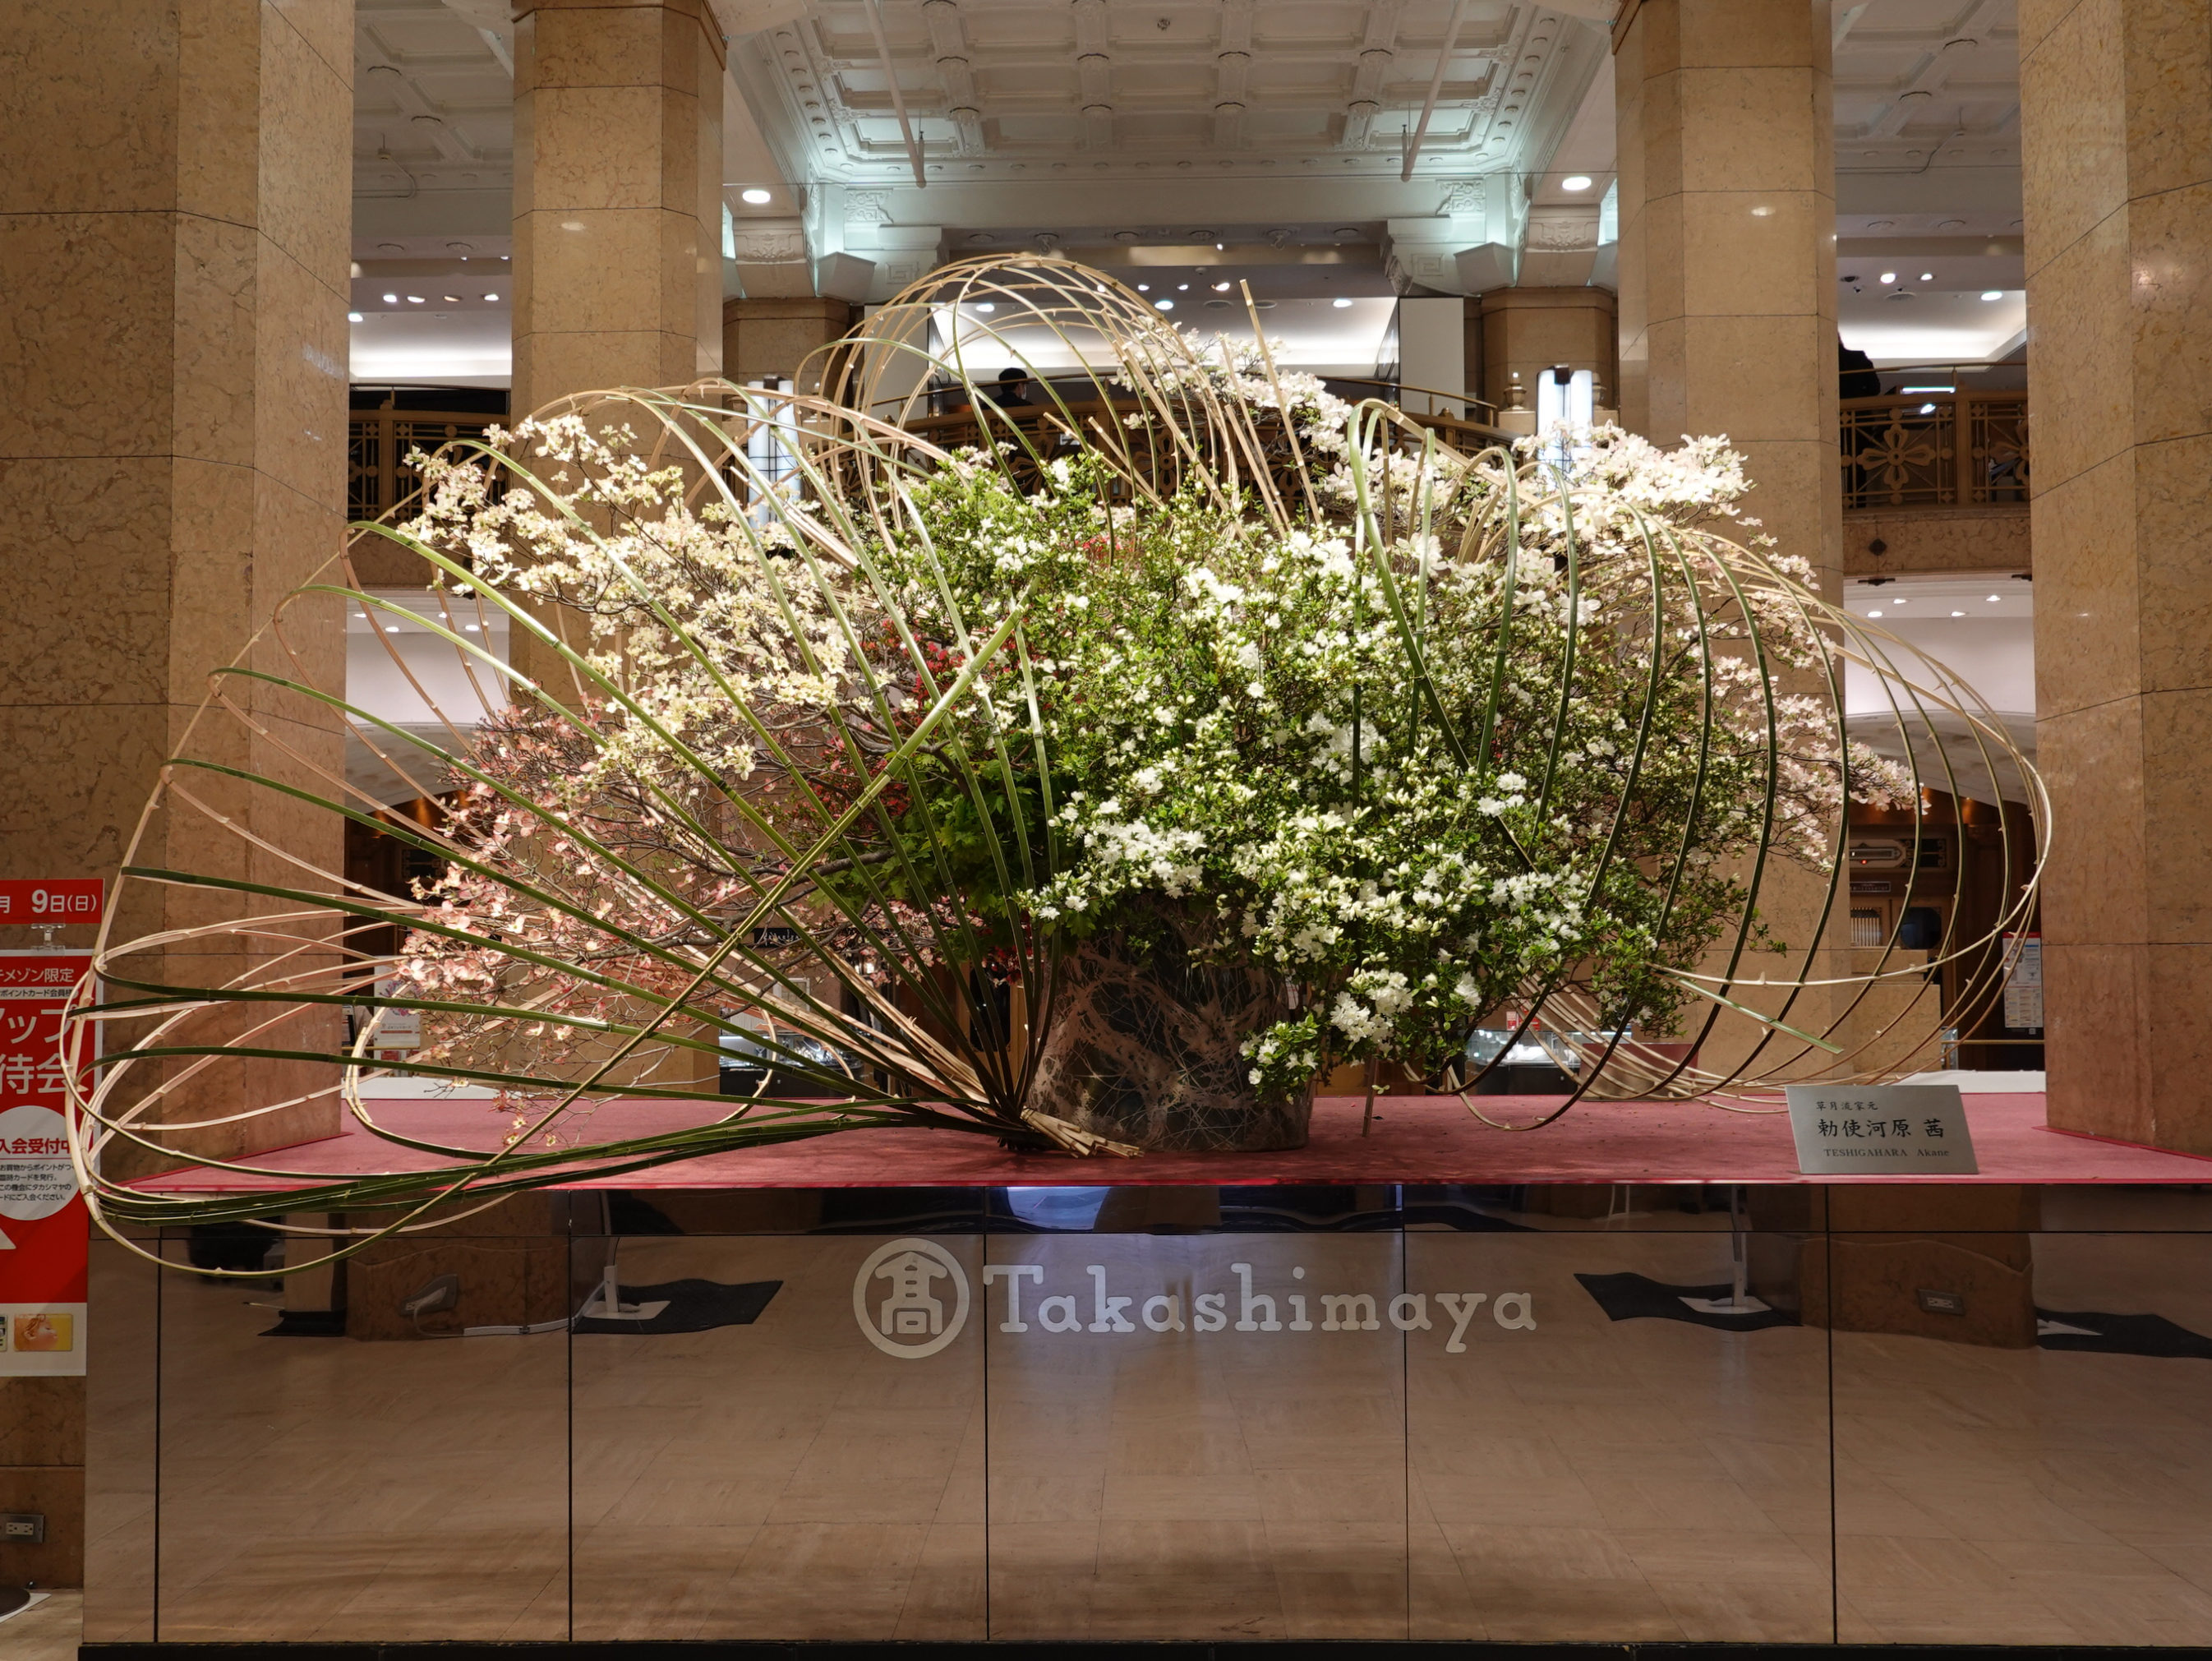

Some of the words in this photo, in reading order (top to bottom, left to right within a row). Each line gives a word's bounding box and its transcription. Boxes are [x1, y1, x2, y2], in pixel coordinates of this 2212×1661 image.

[0, 968, 74, 983] メゾン限定
[0, 1004, 78, 1045] ップ
[1816, 1100, 1878, 1110] 草月流家元
[1818, 1119, 1911, 1138] 勅使河原
[1924, 1119, 1943, 1138] 茜
[1823, 1148, 1907, 1157] TESHIGAHARA
[1917, 1148, 1950, 1157] Akane
[983, 1263, 1537, 1354] Takashimaya
